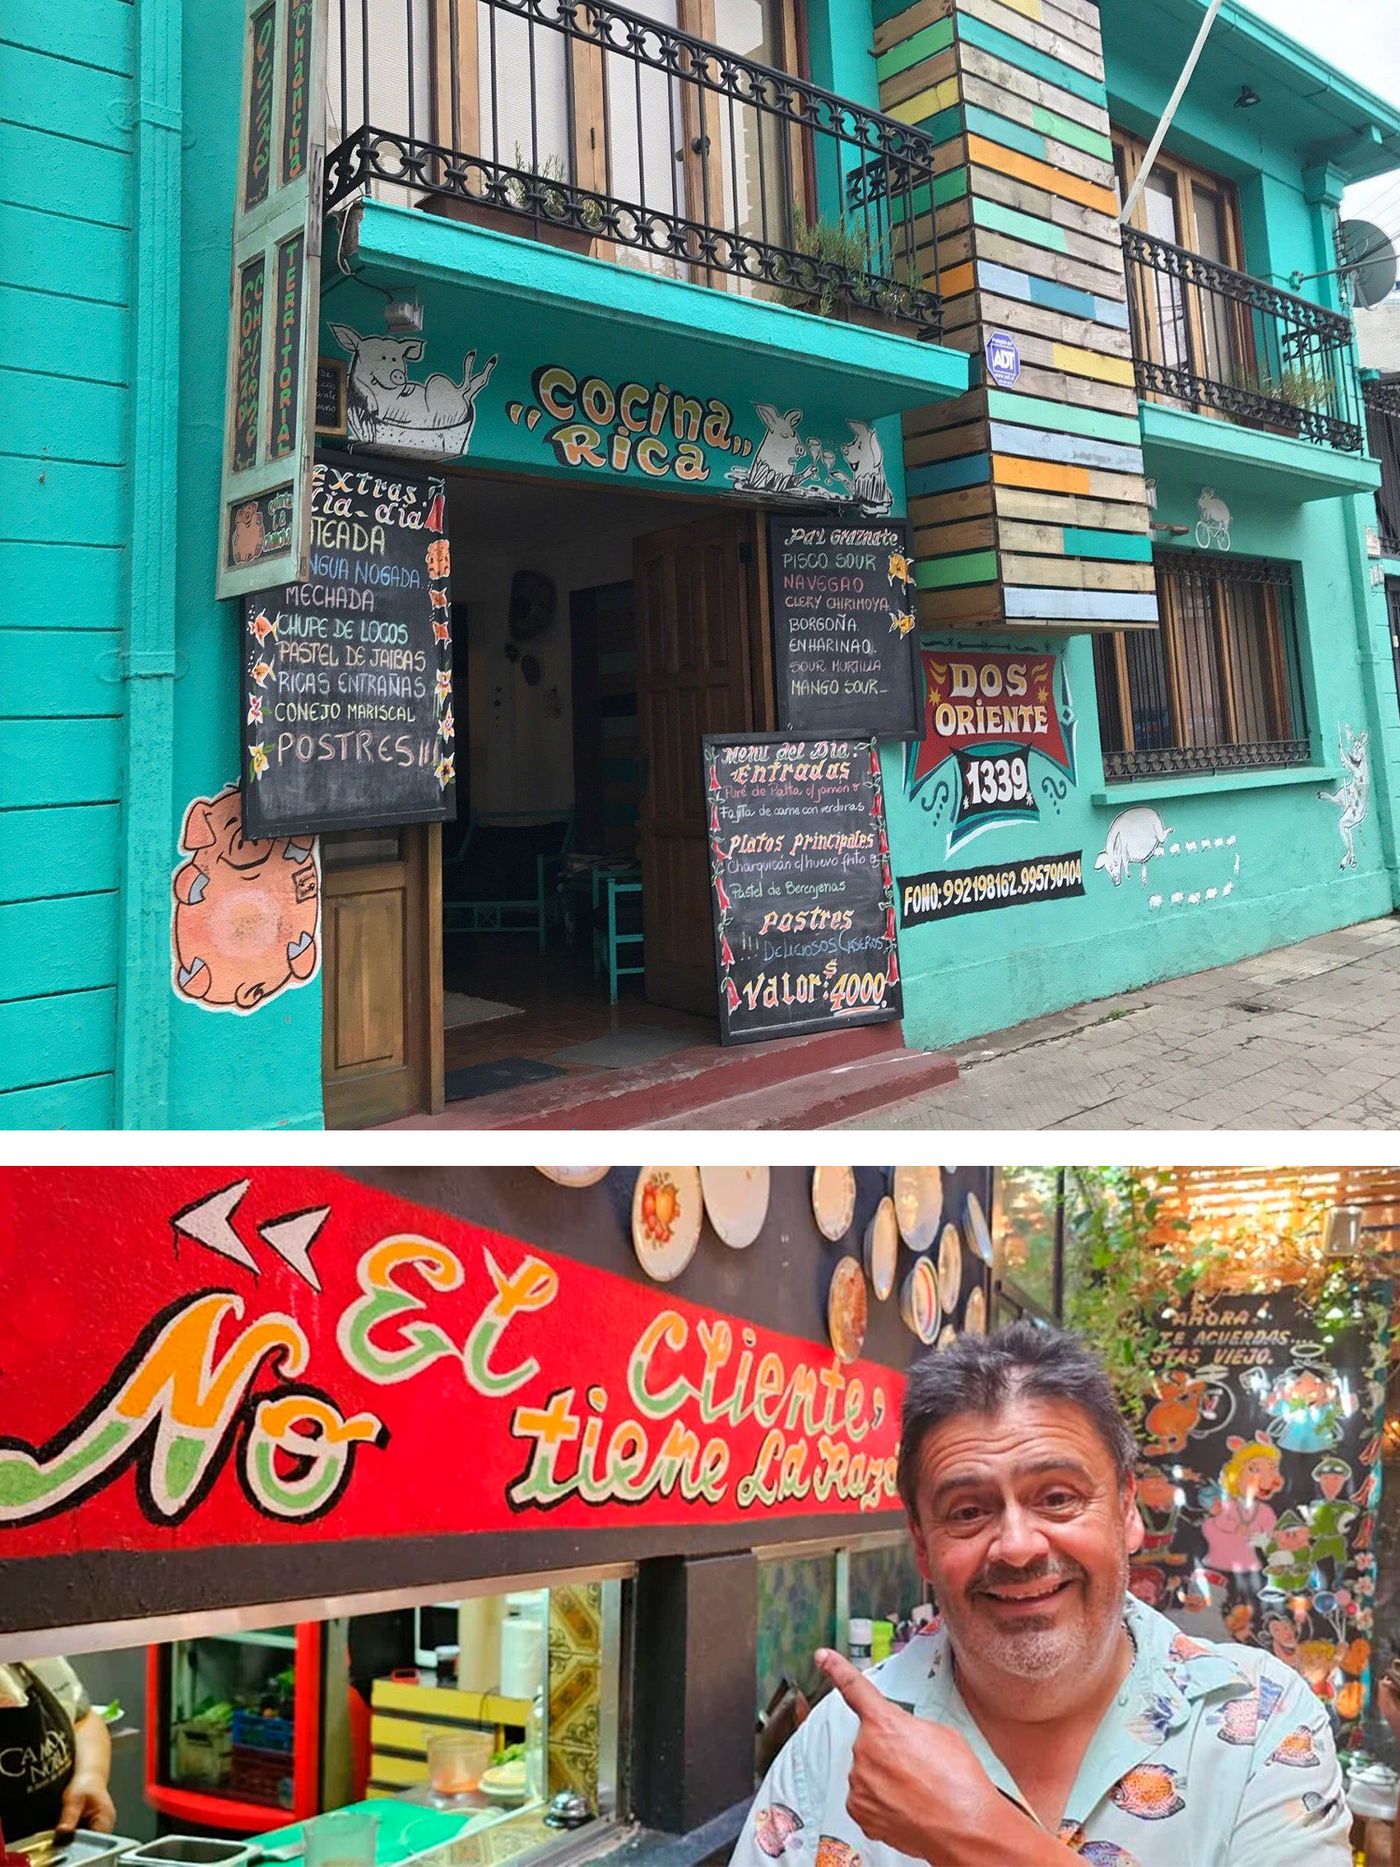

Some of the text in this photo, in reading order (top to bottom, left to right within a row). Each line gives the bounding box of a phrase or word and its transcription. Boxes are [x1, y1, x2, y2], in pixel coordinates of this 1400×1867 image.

[993, 349, 1015, 370] ADT
[782, 553, 877, 571] PISCO SOUR
[783, 574, 864, 593] NAVEGAO
[285, 583, 375, 613] MECHADA
[278, 613, 409, 645] CHUPE DE LOCOS
[275, 640, 427, 672] PASTEL DE JAIBAS
[789, 660, 826, 673] SOUR
[278, 671, 427, 698] RICAS ENTRAÑAS
[791, 679, 839, 696] MANGO
[948, 663, 1027, 698] DOS
[274, 702, 416, 723] CONEJO MARISCAL
[776, 741, 805, 762] del
[752, 784, 765, 797] de
[966, 757, 1028, 804] 1339
[759, 803, 771, 816] de
[772, 807, 800, 816] carne
[802, 805, 818, 814] con
[729, 882, 763, 900] Pastel
[767, 882, 782, 896] de
[1159, 1330, 1185, 1345] TE
[0, 1288, 391, 1526] No
[508, 1388, 730, 1512] tiene
[737, 1428, 810, 1508] La
